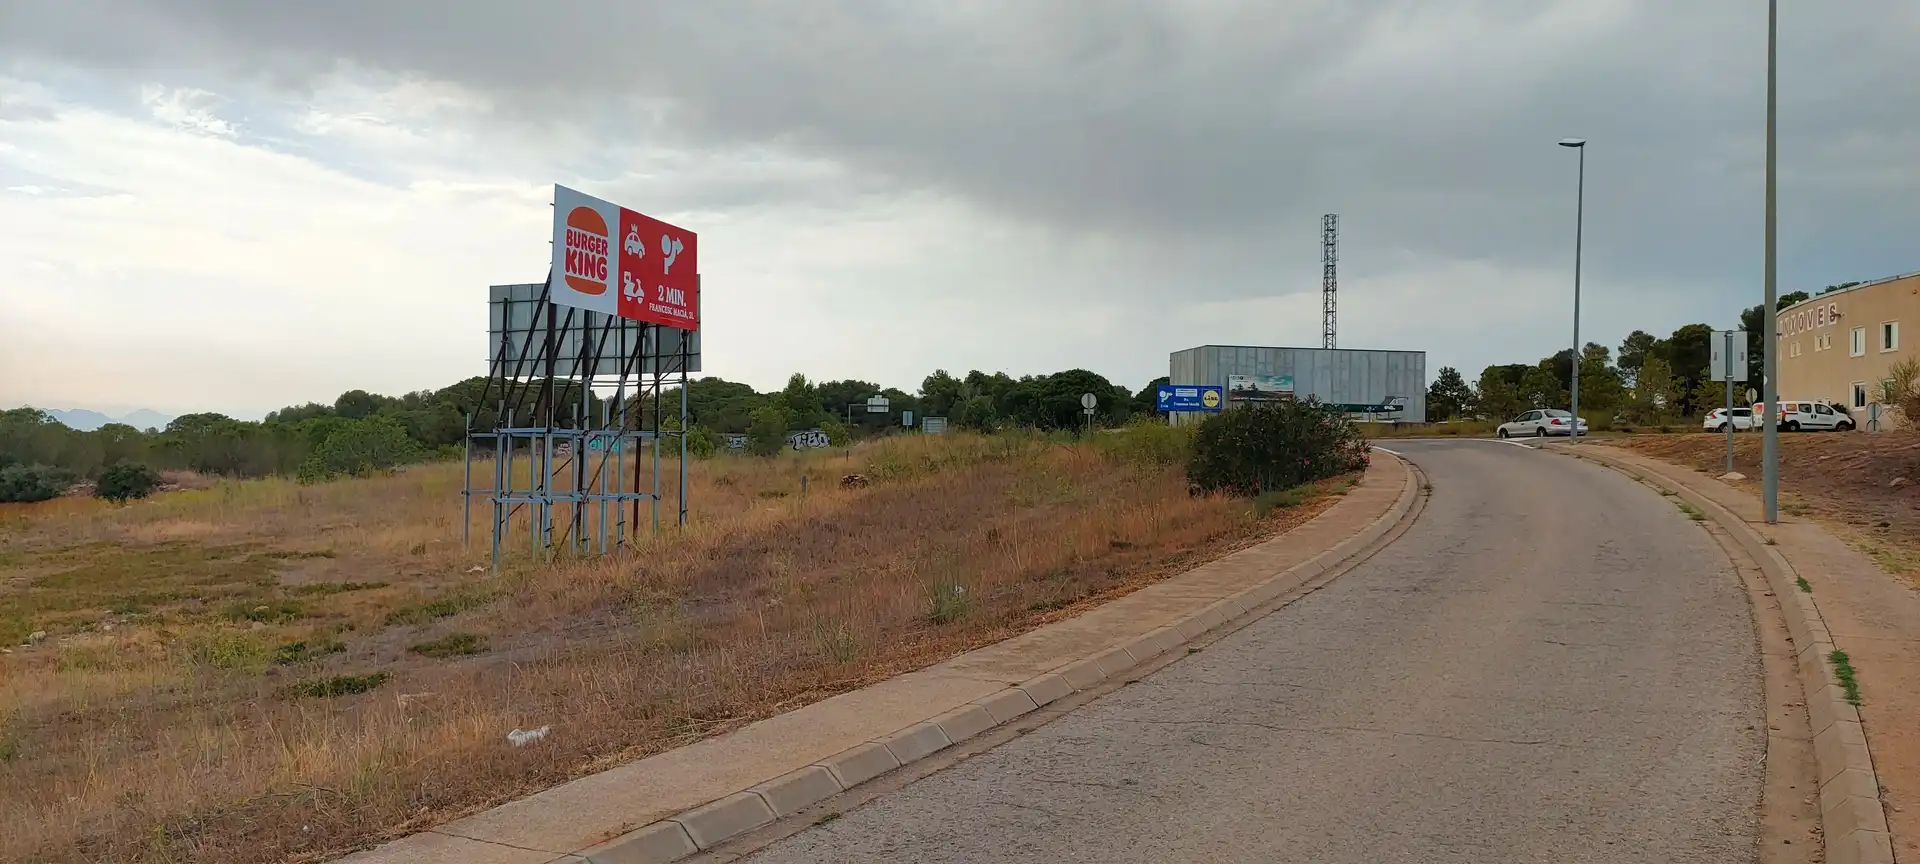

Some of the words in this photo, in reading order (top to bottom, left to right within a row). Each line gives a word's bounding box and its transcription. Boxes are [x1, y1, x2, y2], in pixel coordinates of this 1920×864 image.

[566, 229, 608, 256] BURGER
[565, 247, 607, 281] KING
[658, 284, 664, 302] 2
[666, 286, 687, 307] MIN.
[649, 302, 672, 315] FRANCESC
